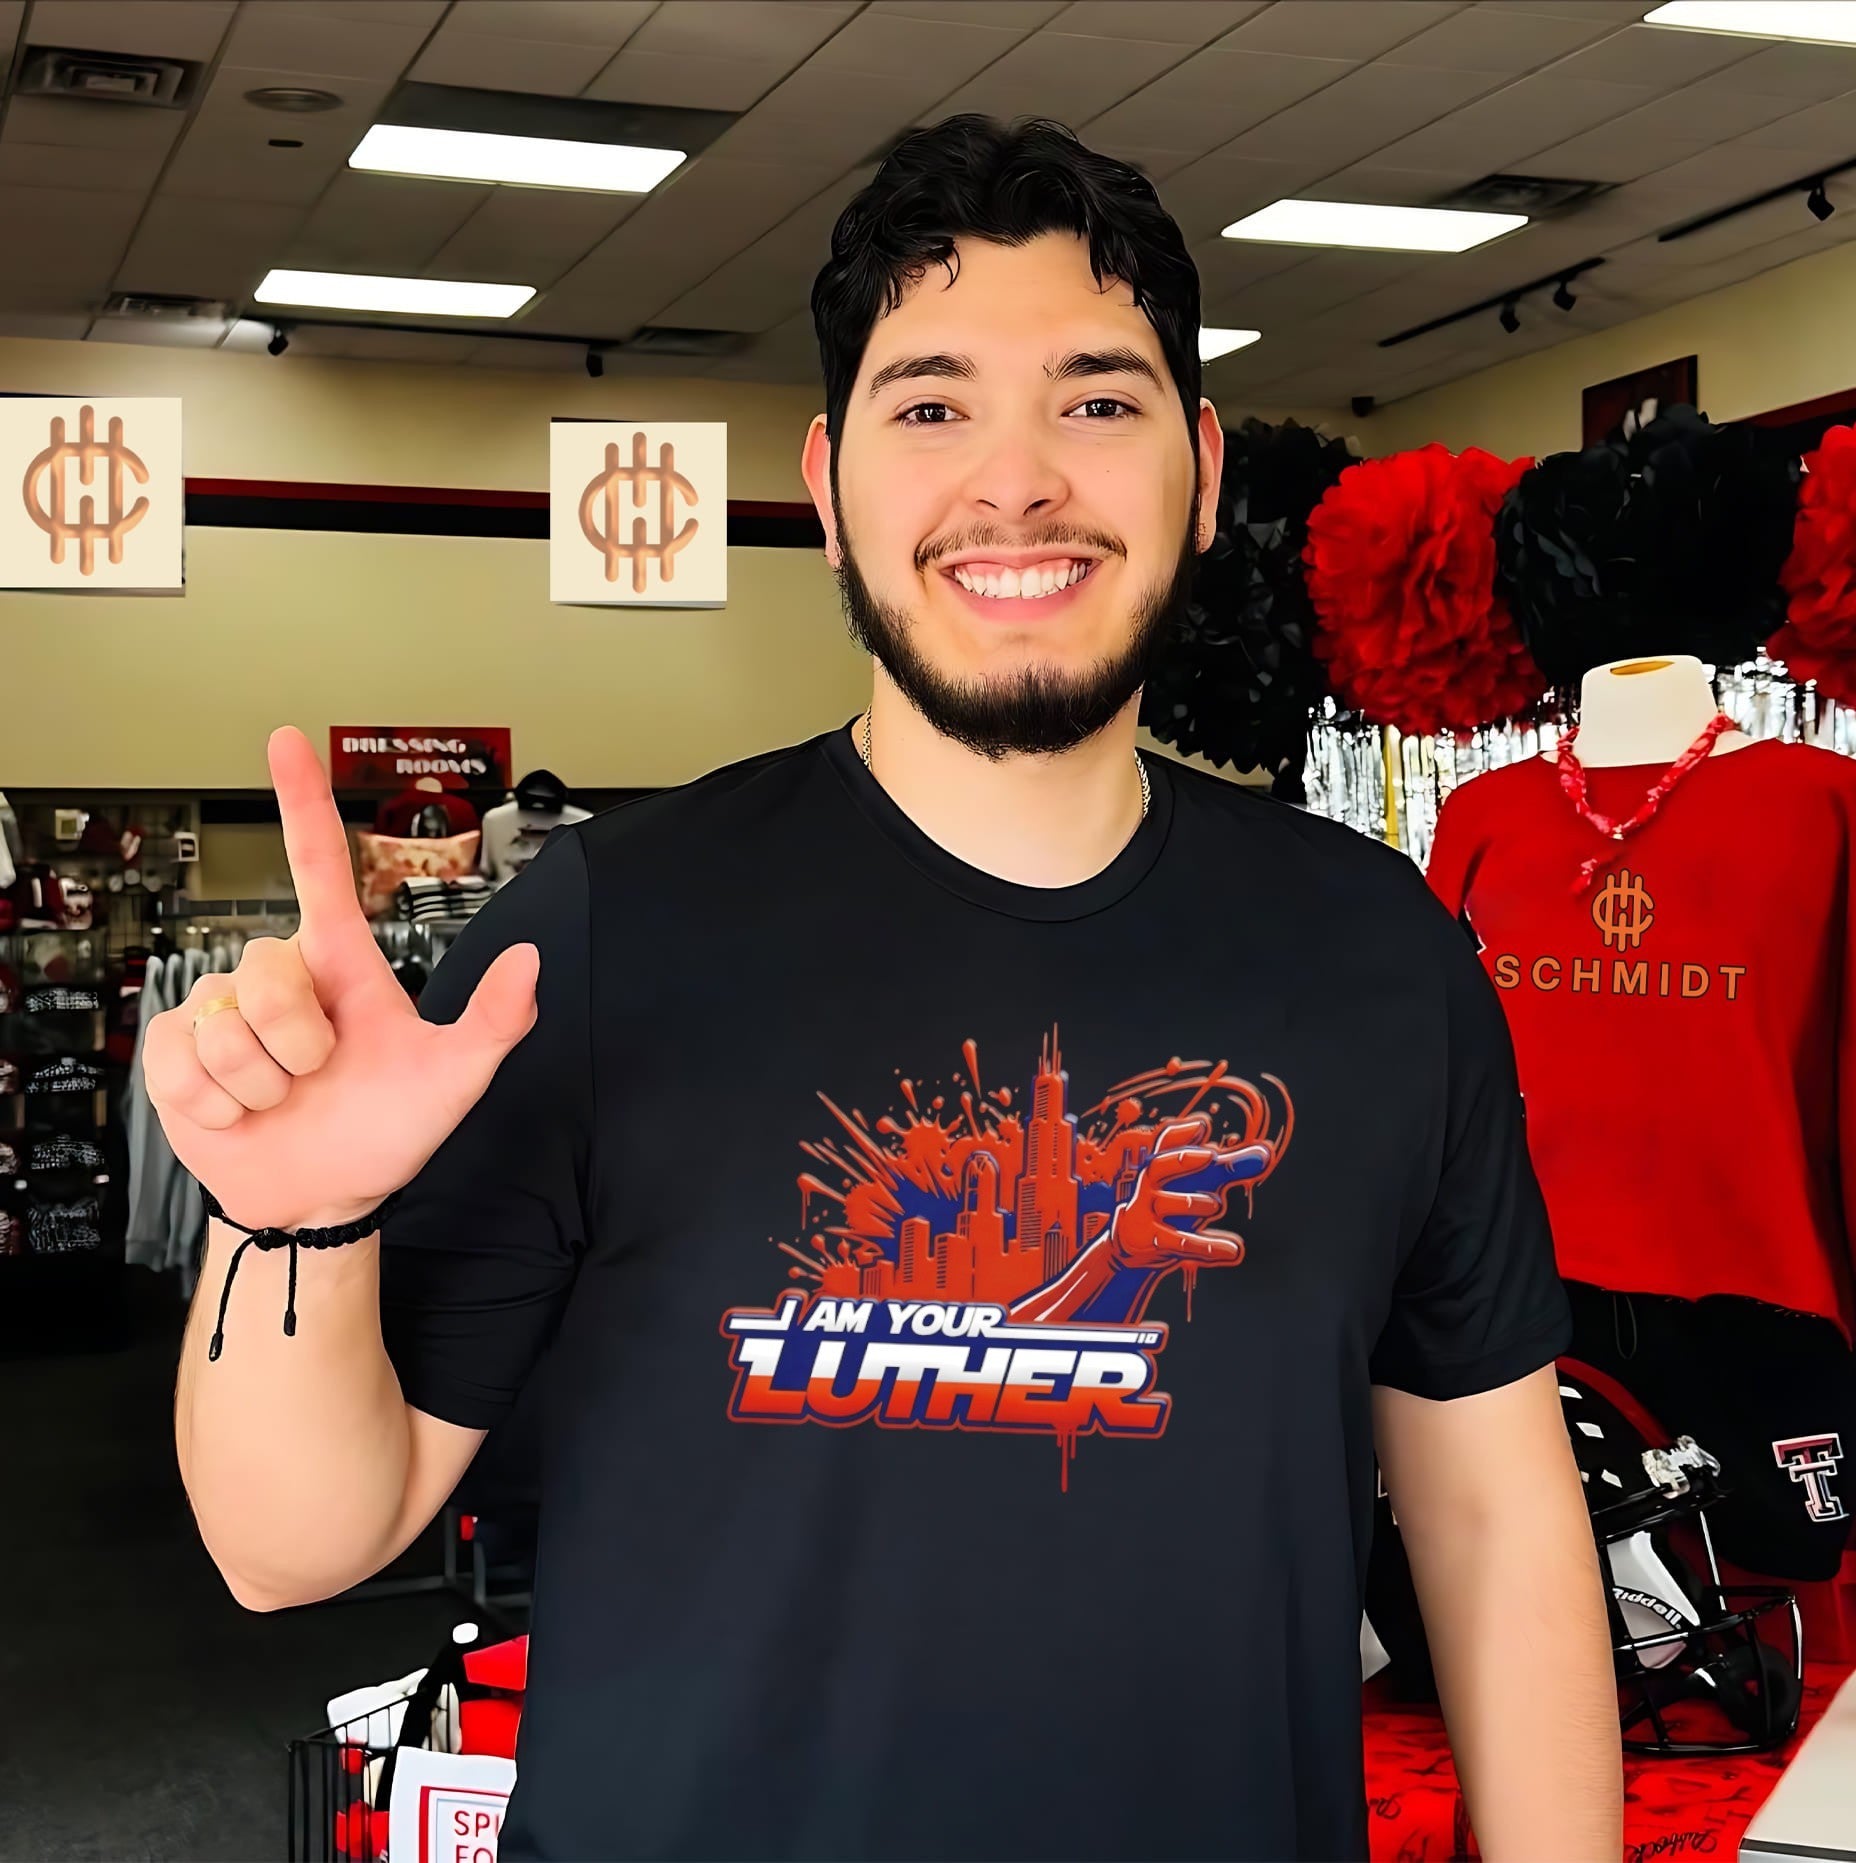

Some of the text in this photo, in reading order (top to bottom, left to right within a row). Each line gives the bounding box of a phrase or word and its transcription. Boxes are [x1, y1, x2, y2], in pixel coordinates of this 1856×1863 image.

[396, 758, 487, 775] ROOMS
[1494, 954, 1746, 1001] SCHMIDT
[804, 1301, 873, 1334] AM
[886, 1302, 1003, 1339] YOUR
[736, 1337, 1165, 1428] LUTHER
